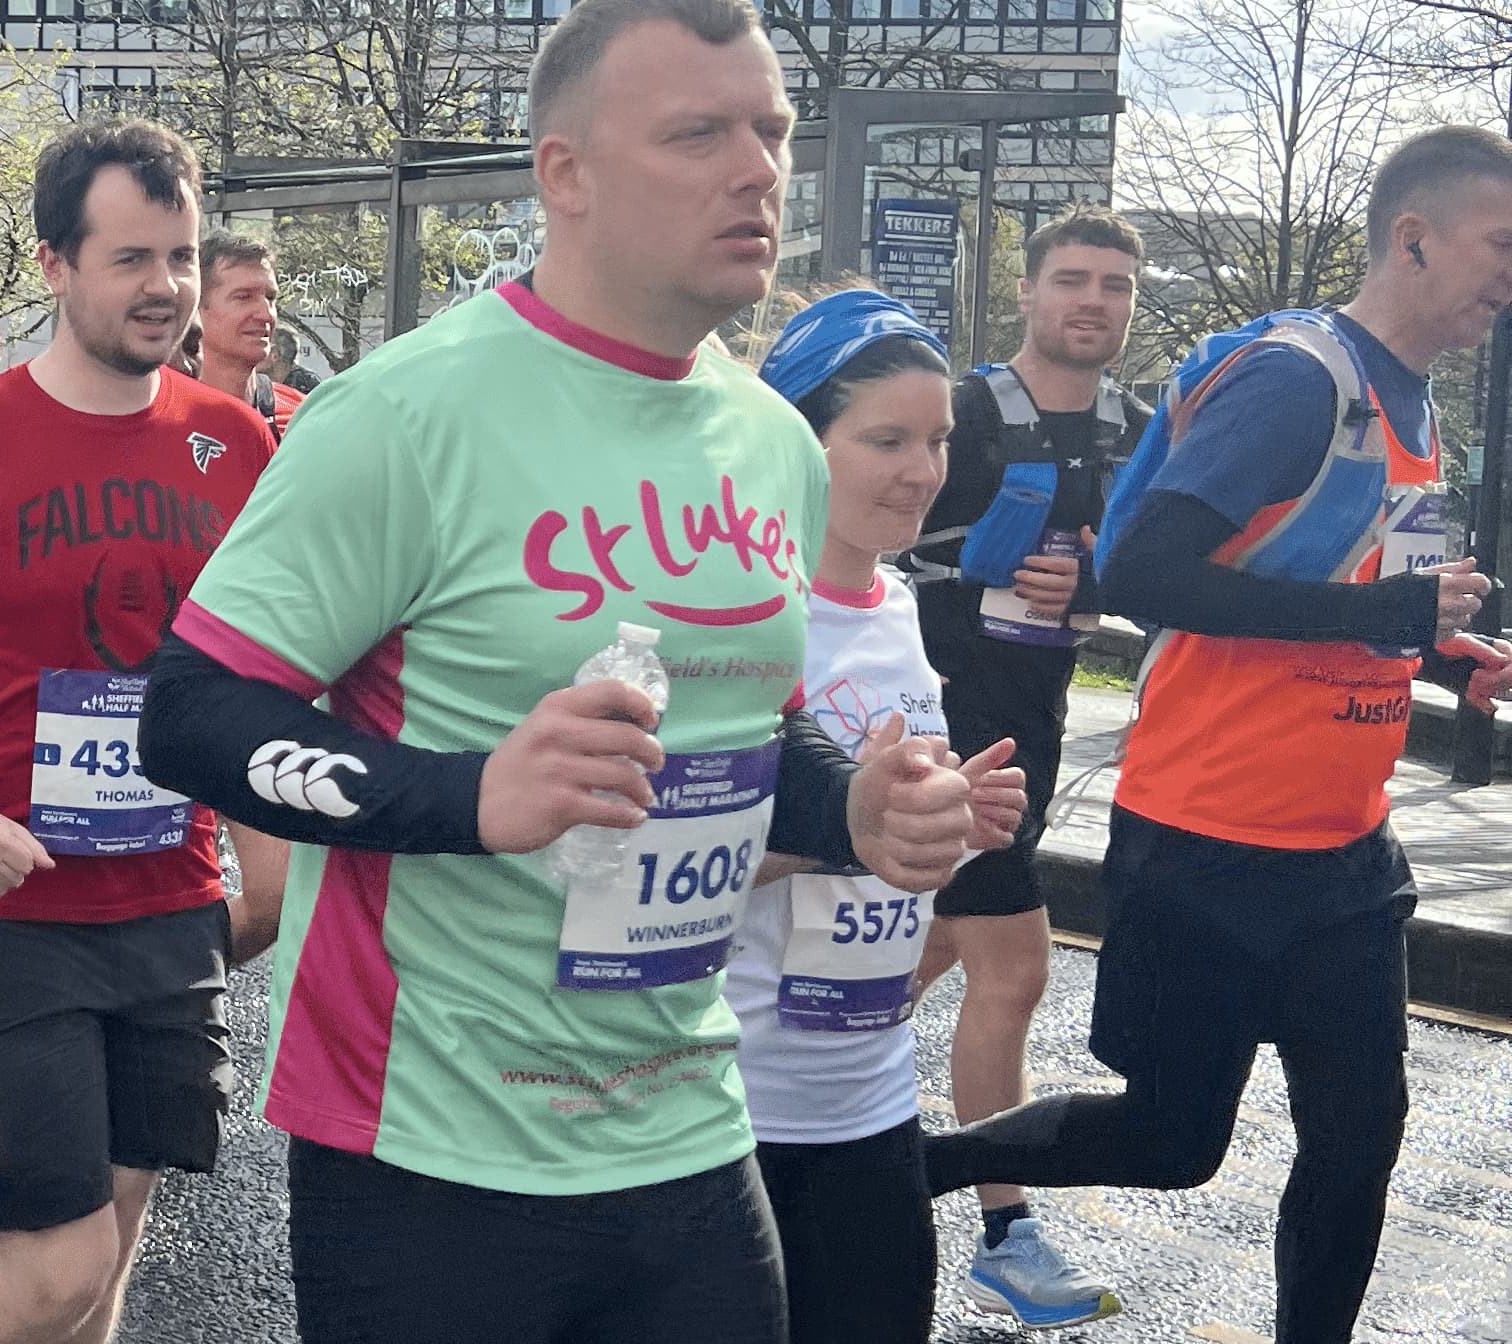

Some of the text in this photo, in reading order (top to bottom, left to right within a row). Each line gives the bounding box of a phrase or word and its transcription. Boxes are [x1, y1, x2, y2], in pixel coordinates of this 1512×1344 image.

[884, 215, 951, 234] TEKKERS
[17, 479, 226, 570] FALCONS
[523, 474, 803, 622] St Luke's
[105, 703, 130, 712] HALF
[106, 694, 144, 703] SHEFFIEL
[70, 740, 145, 778] 43
[95, 789, 154, 802] THOMAS
[638, 838, 753, 905] 1608
[626, 912, 735, 943] WINNERBURN
[832, 896, 919, 944] 5575
[810, 987, 827, 997] FOR
[829, 989, 844, 999] ALL
